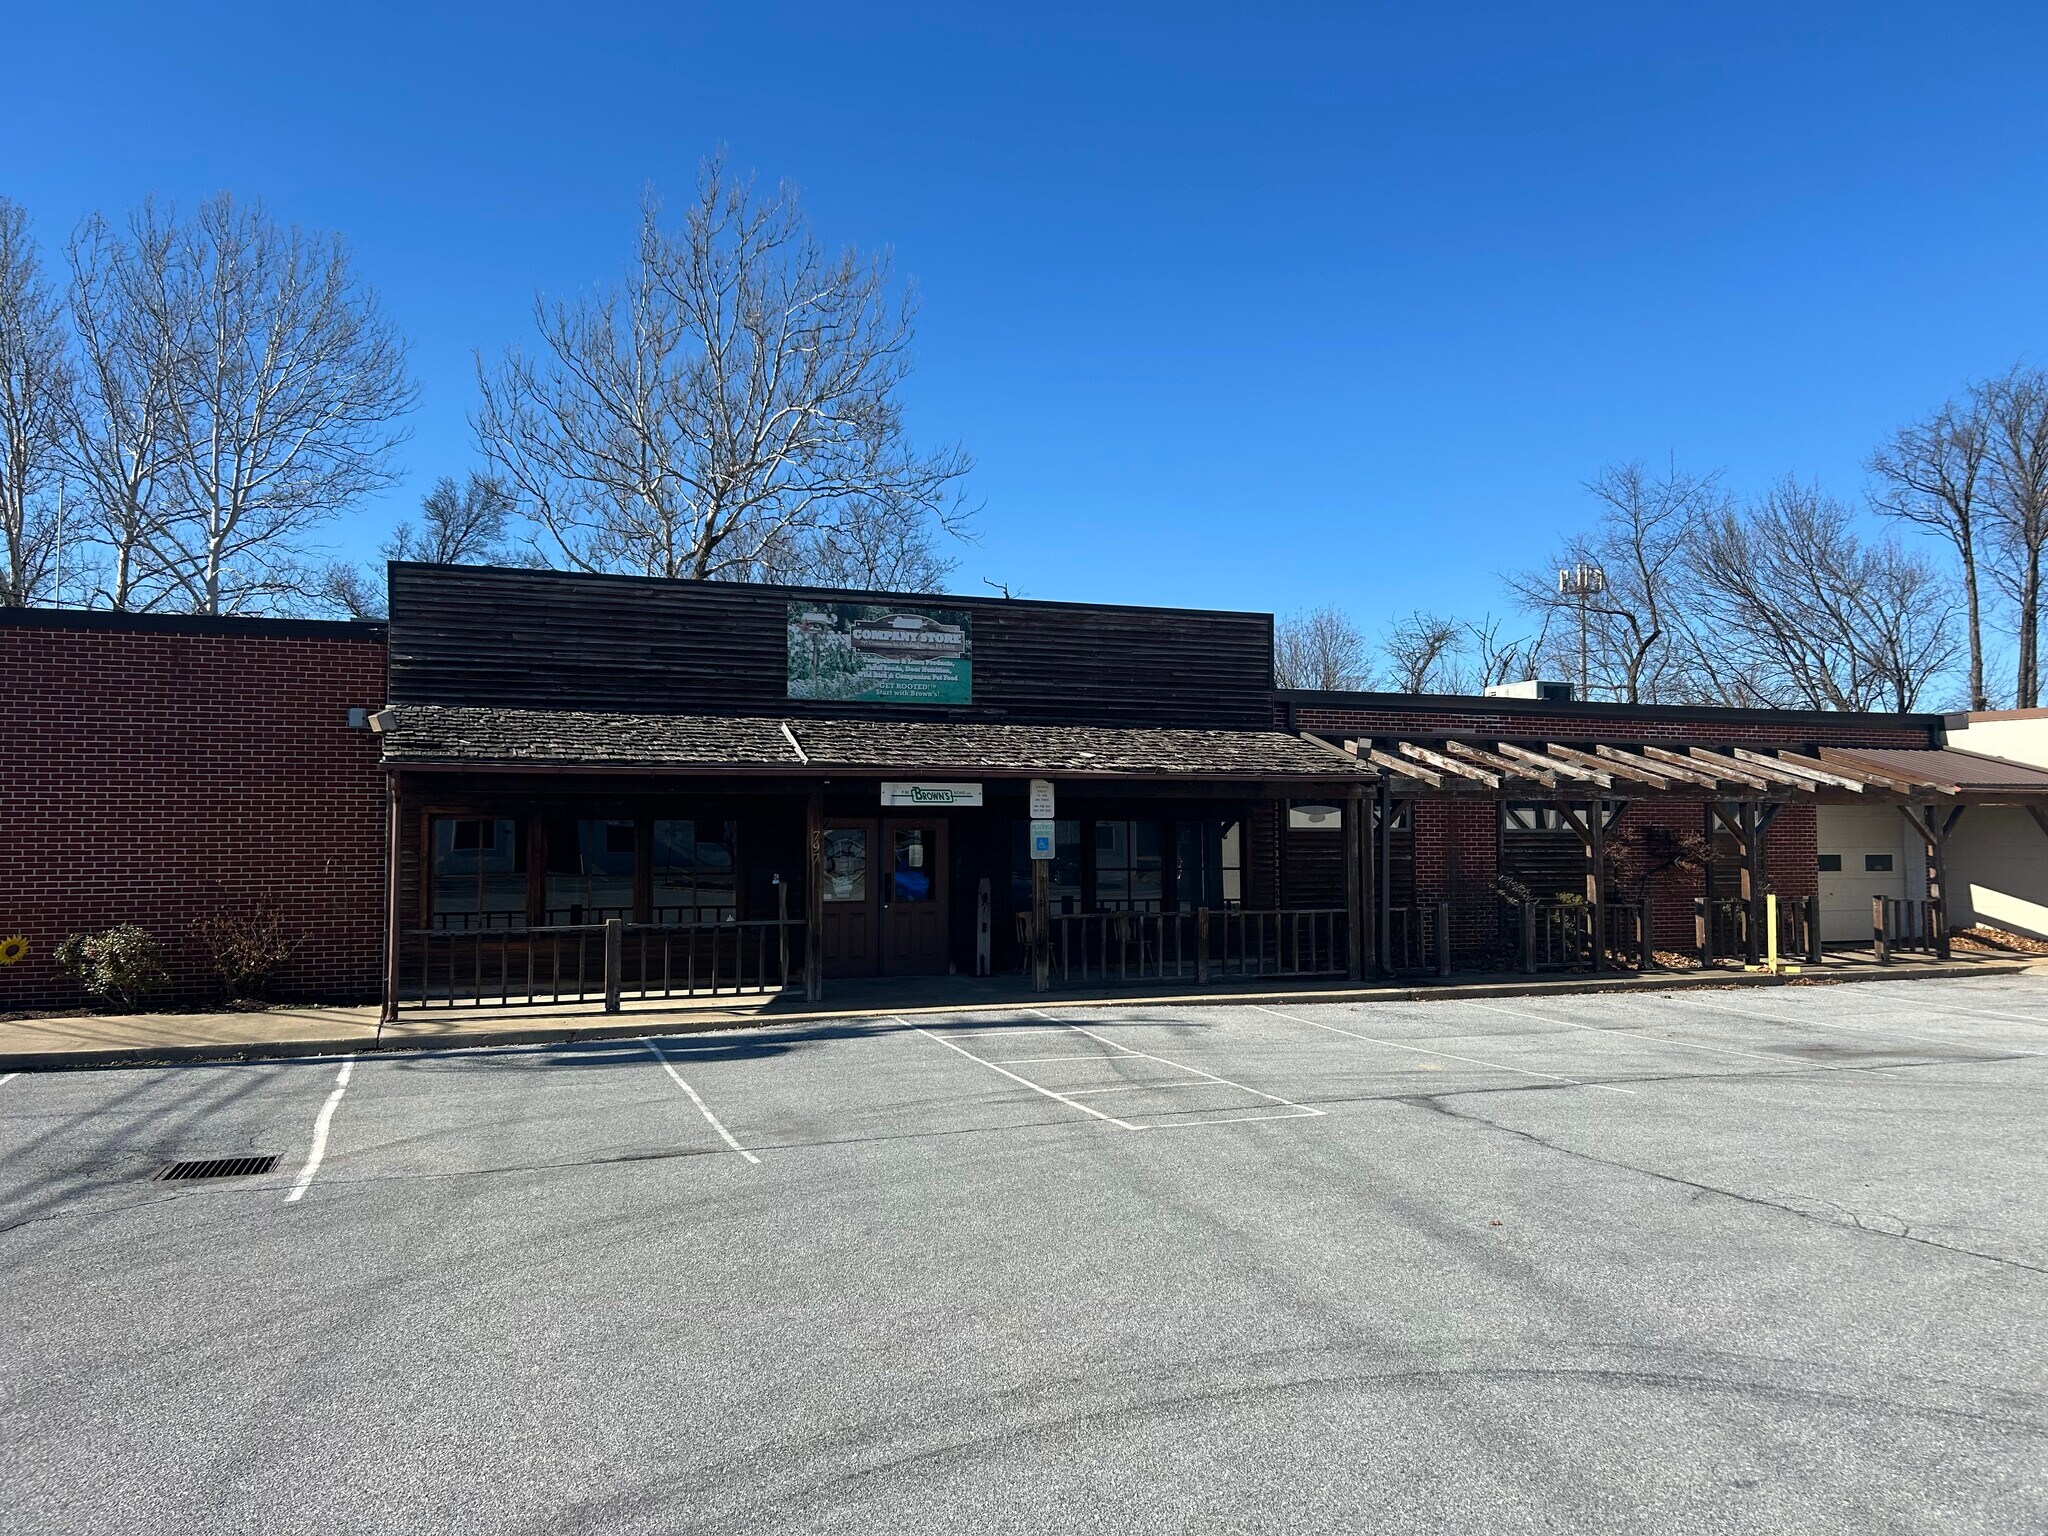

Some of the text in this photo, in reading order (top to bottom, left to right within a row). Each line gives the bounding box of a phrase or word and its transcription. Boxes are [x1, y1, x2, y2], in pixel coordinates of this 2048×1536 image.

[853, 629, 961, 644] COMPANY STORE
[895, 673, 931, 681] Companion
[943, 674, 959, 682] Food
